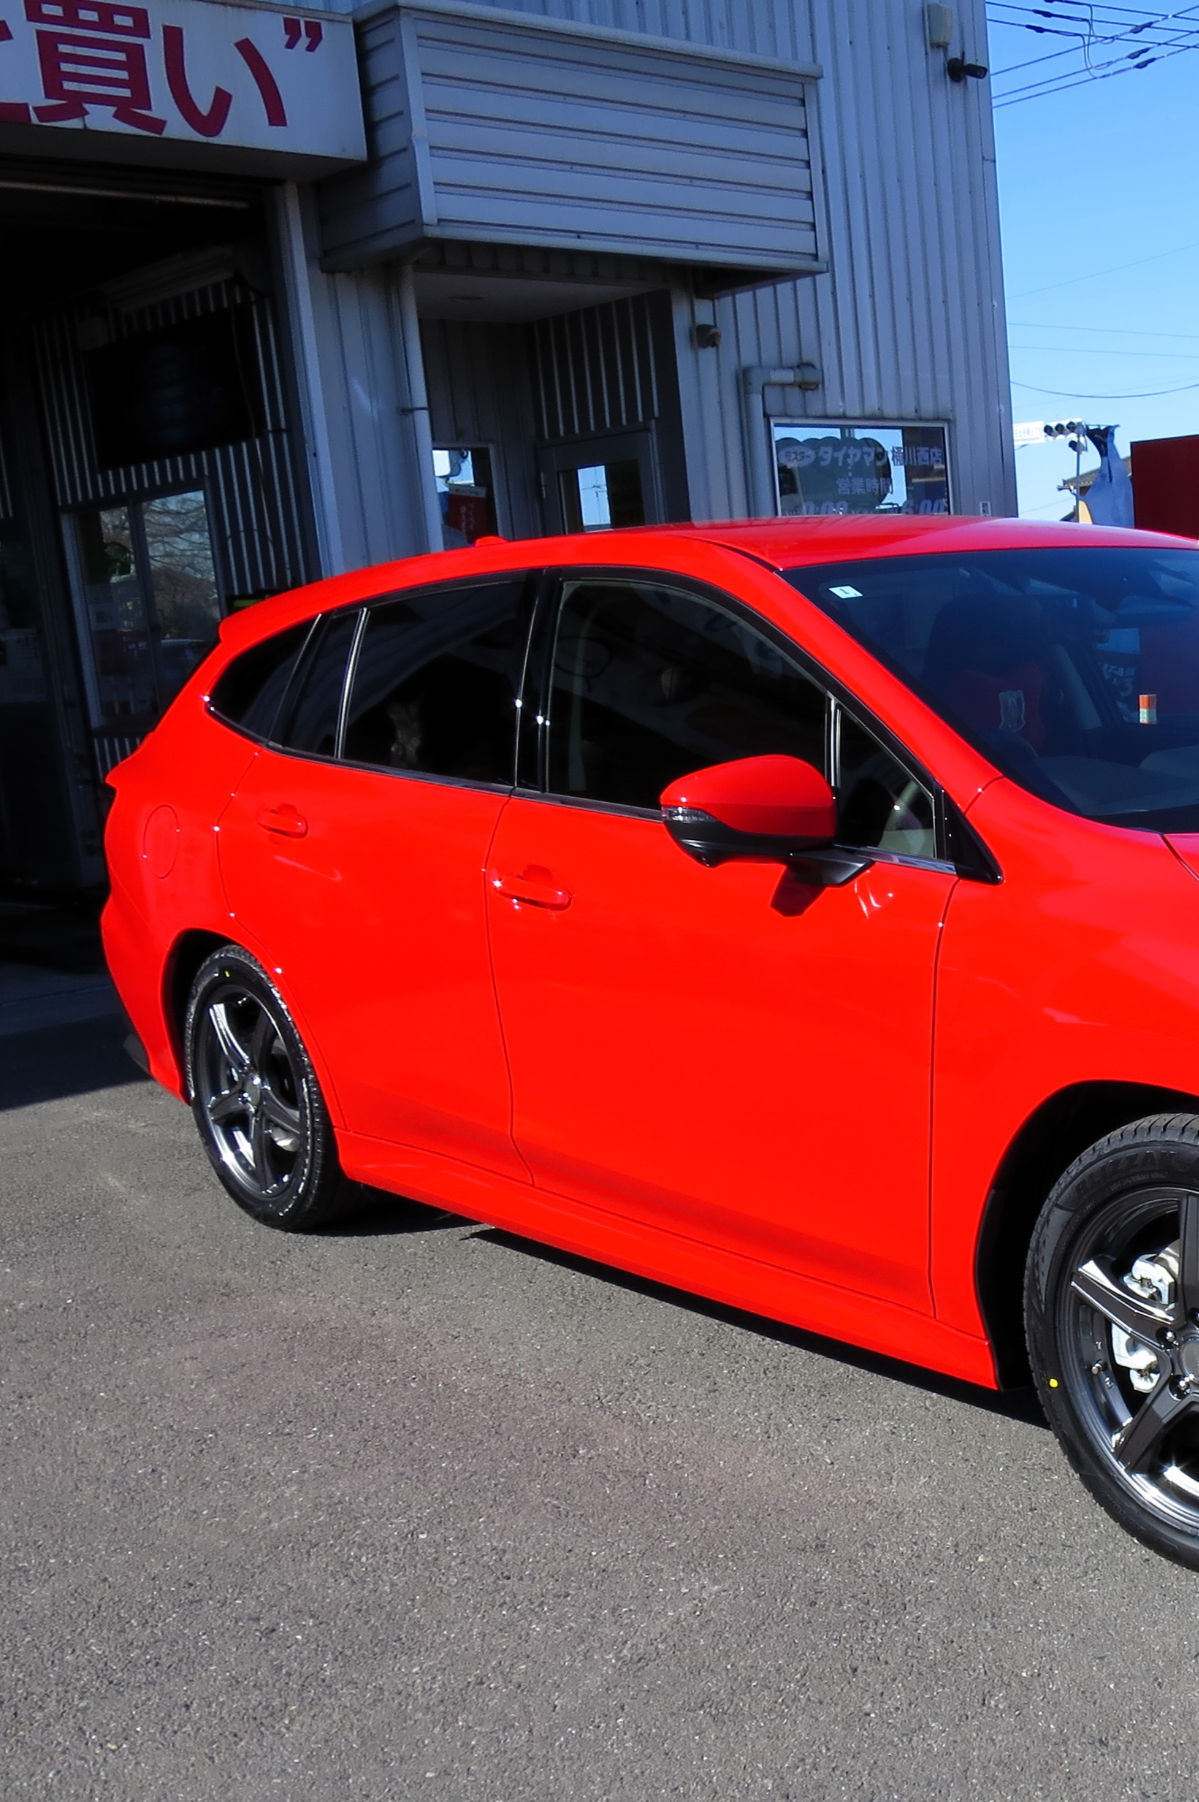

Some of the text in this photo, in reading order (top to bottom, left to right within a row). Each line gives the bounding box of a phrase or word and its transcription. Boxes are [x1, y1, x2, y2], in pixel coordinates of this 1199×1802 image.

[818, 447, 888, 467] タイヤマン
[837, 476, 894, 496] 営業時間
